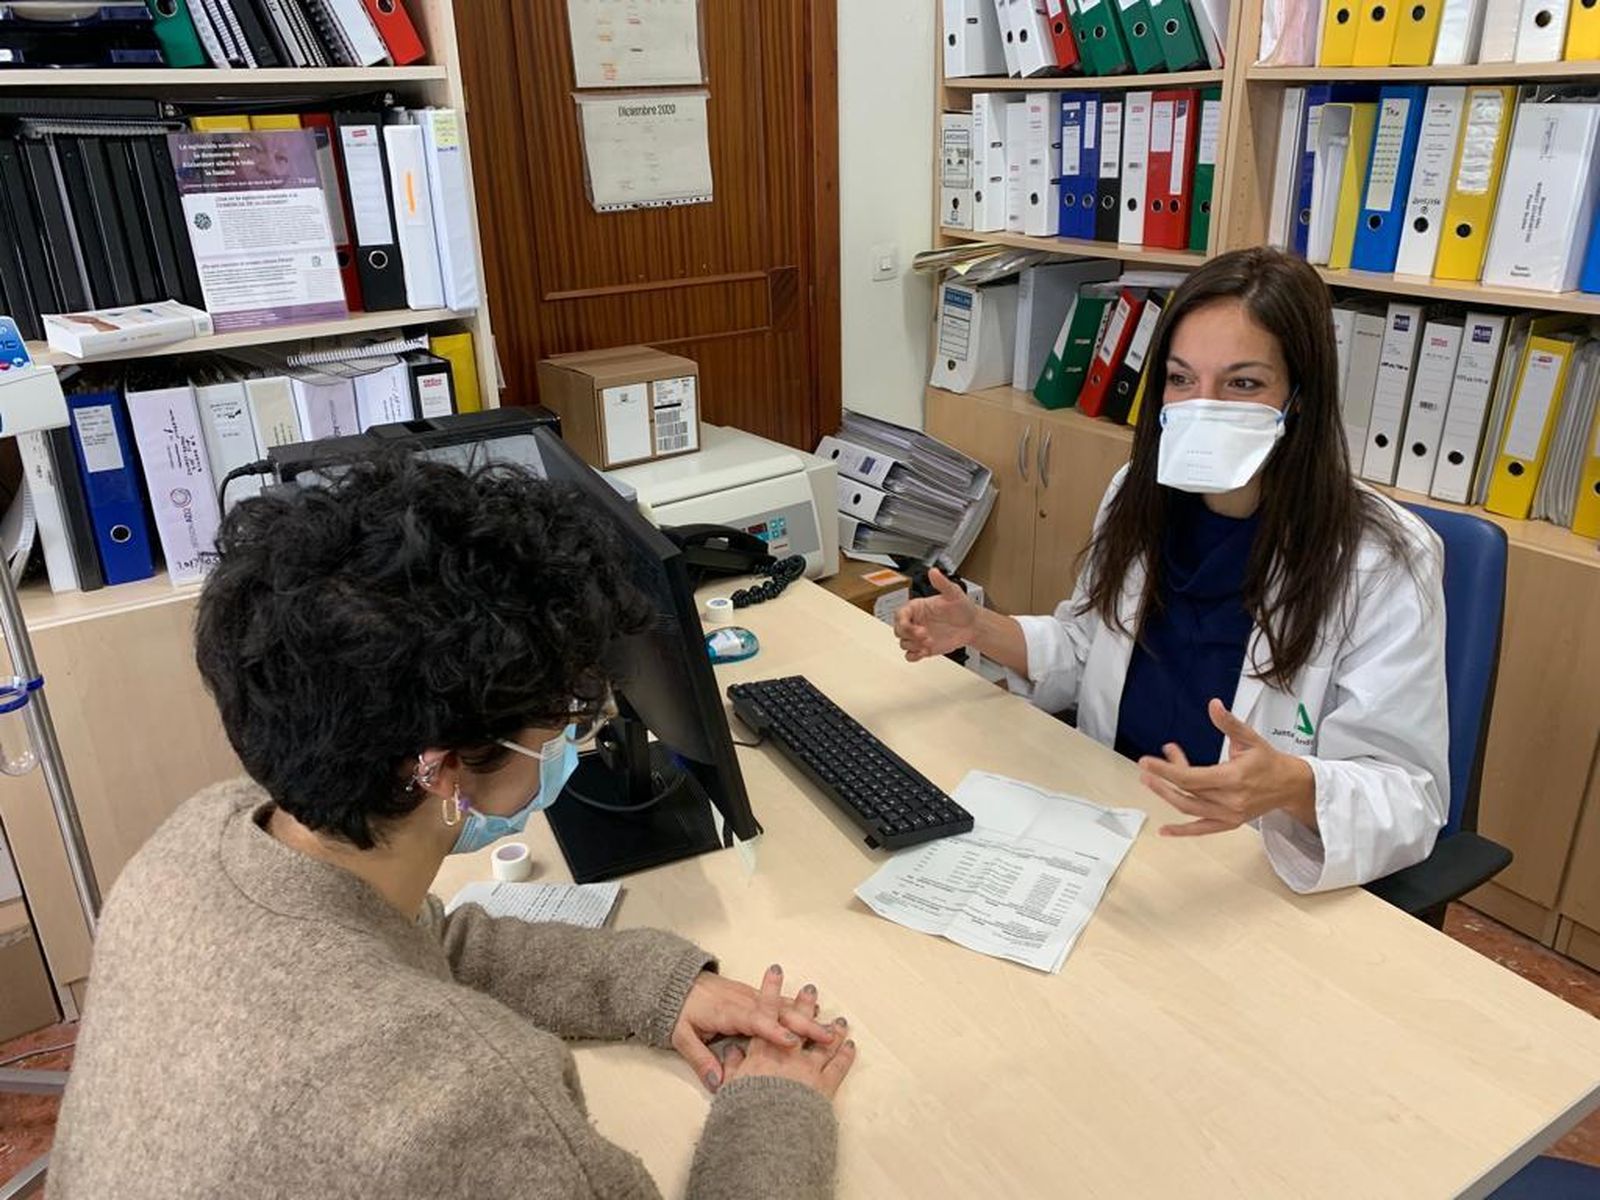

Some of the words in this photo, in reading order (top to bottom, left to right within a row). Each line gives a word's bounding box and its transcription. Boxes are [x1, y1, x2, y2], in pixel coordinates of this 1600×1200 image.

[618, 105, 657, 117] Diciembre
[658, 103, 675, 115] 2020
[1271, 728, 1295, 738] Junta
